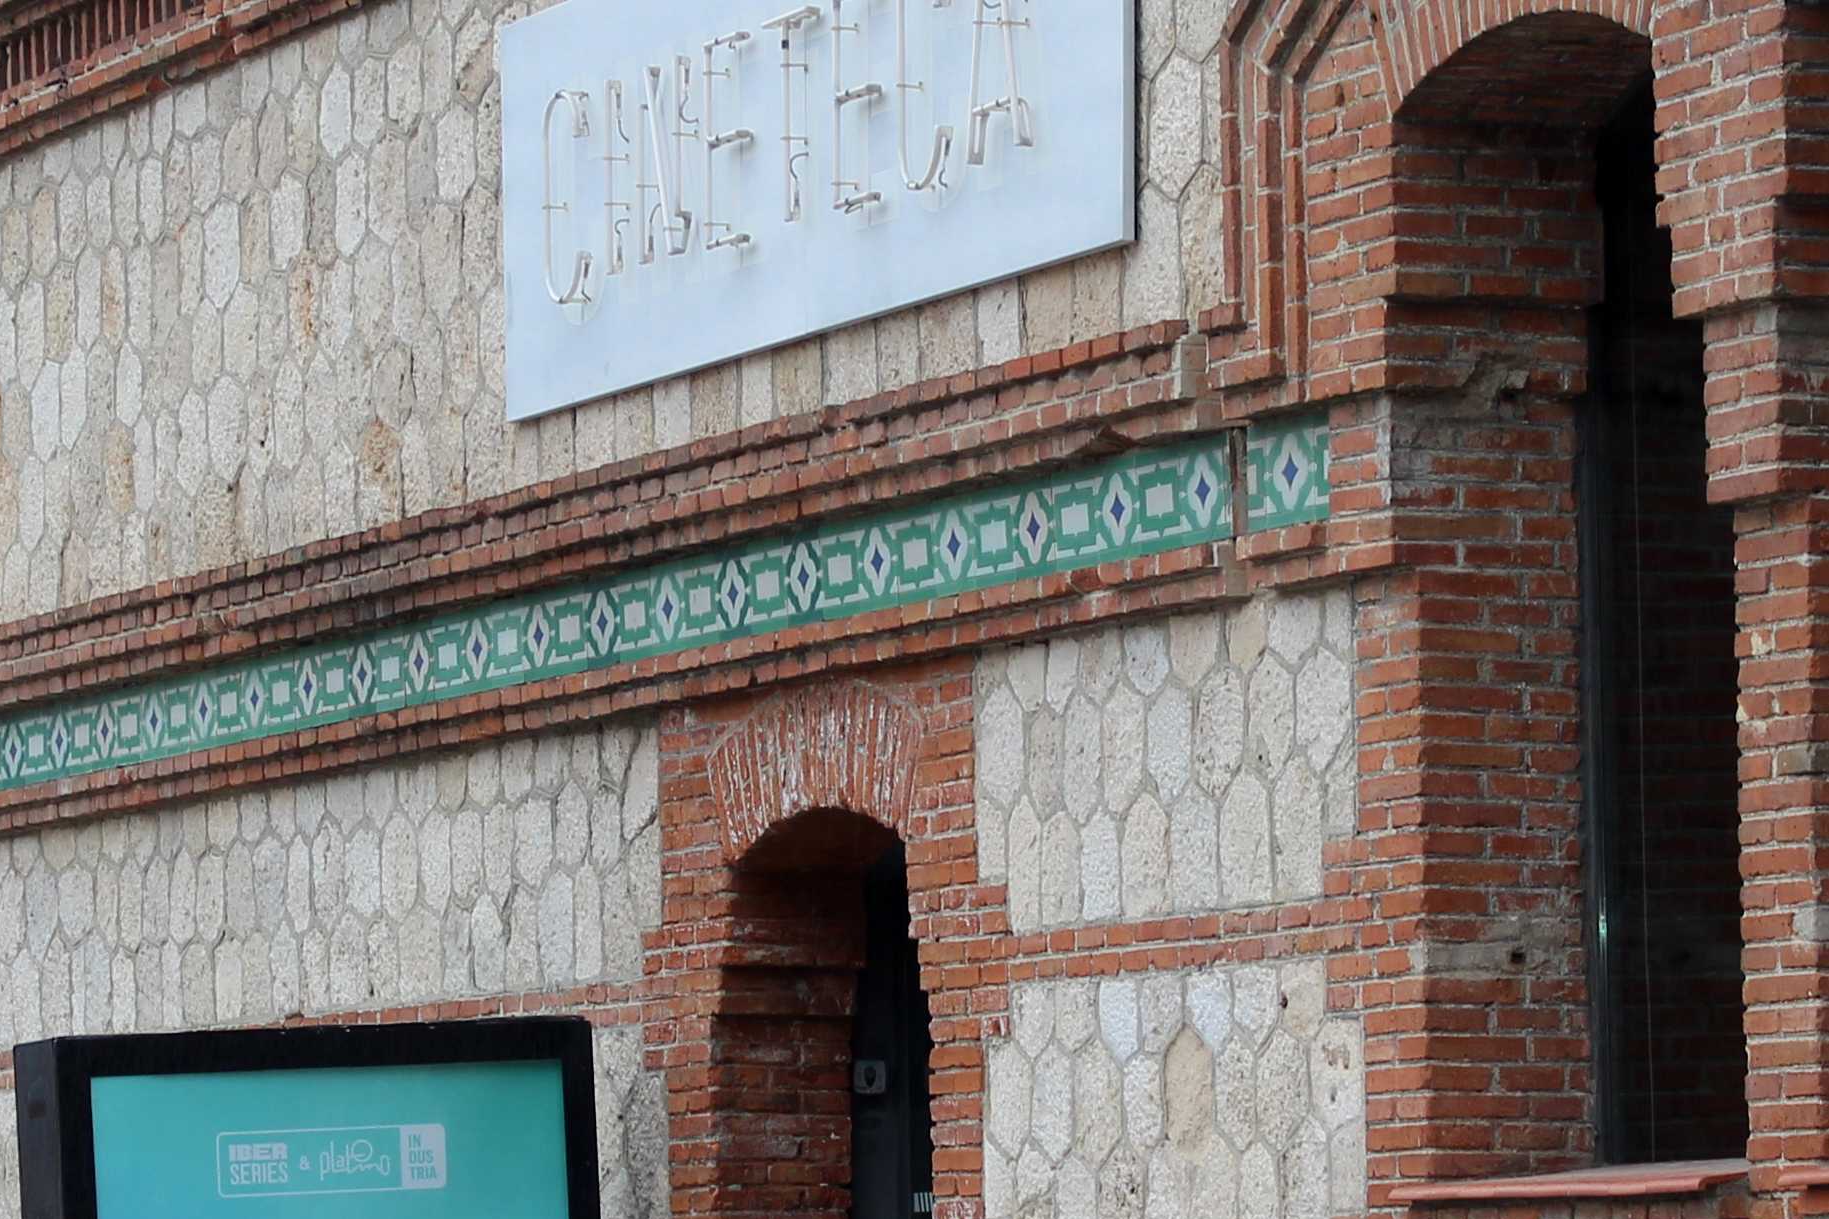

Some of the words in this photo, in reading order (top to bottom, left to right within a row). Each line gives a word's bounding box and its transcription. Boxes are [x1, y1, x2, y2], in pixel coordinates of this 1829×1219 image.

[543, 0, 1033, 304] CINETECA
[228, 1142, 289, 1161] IBER
[407, 1134, 421, 1150] IN
[230, 1161, 289, 1185] SERIES
